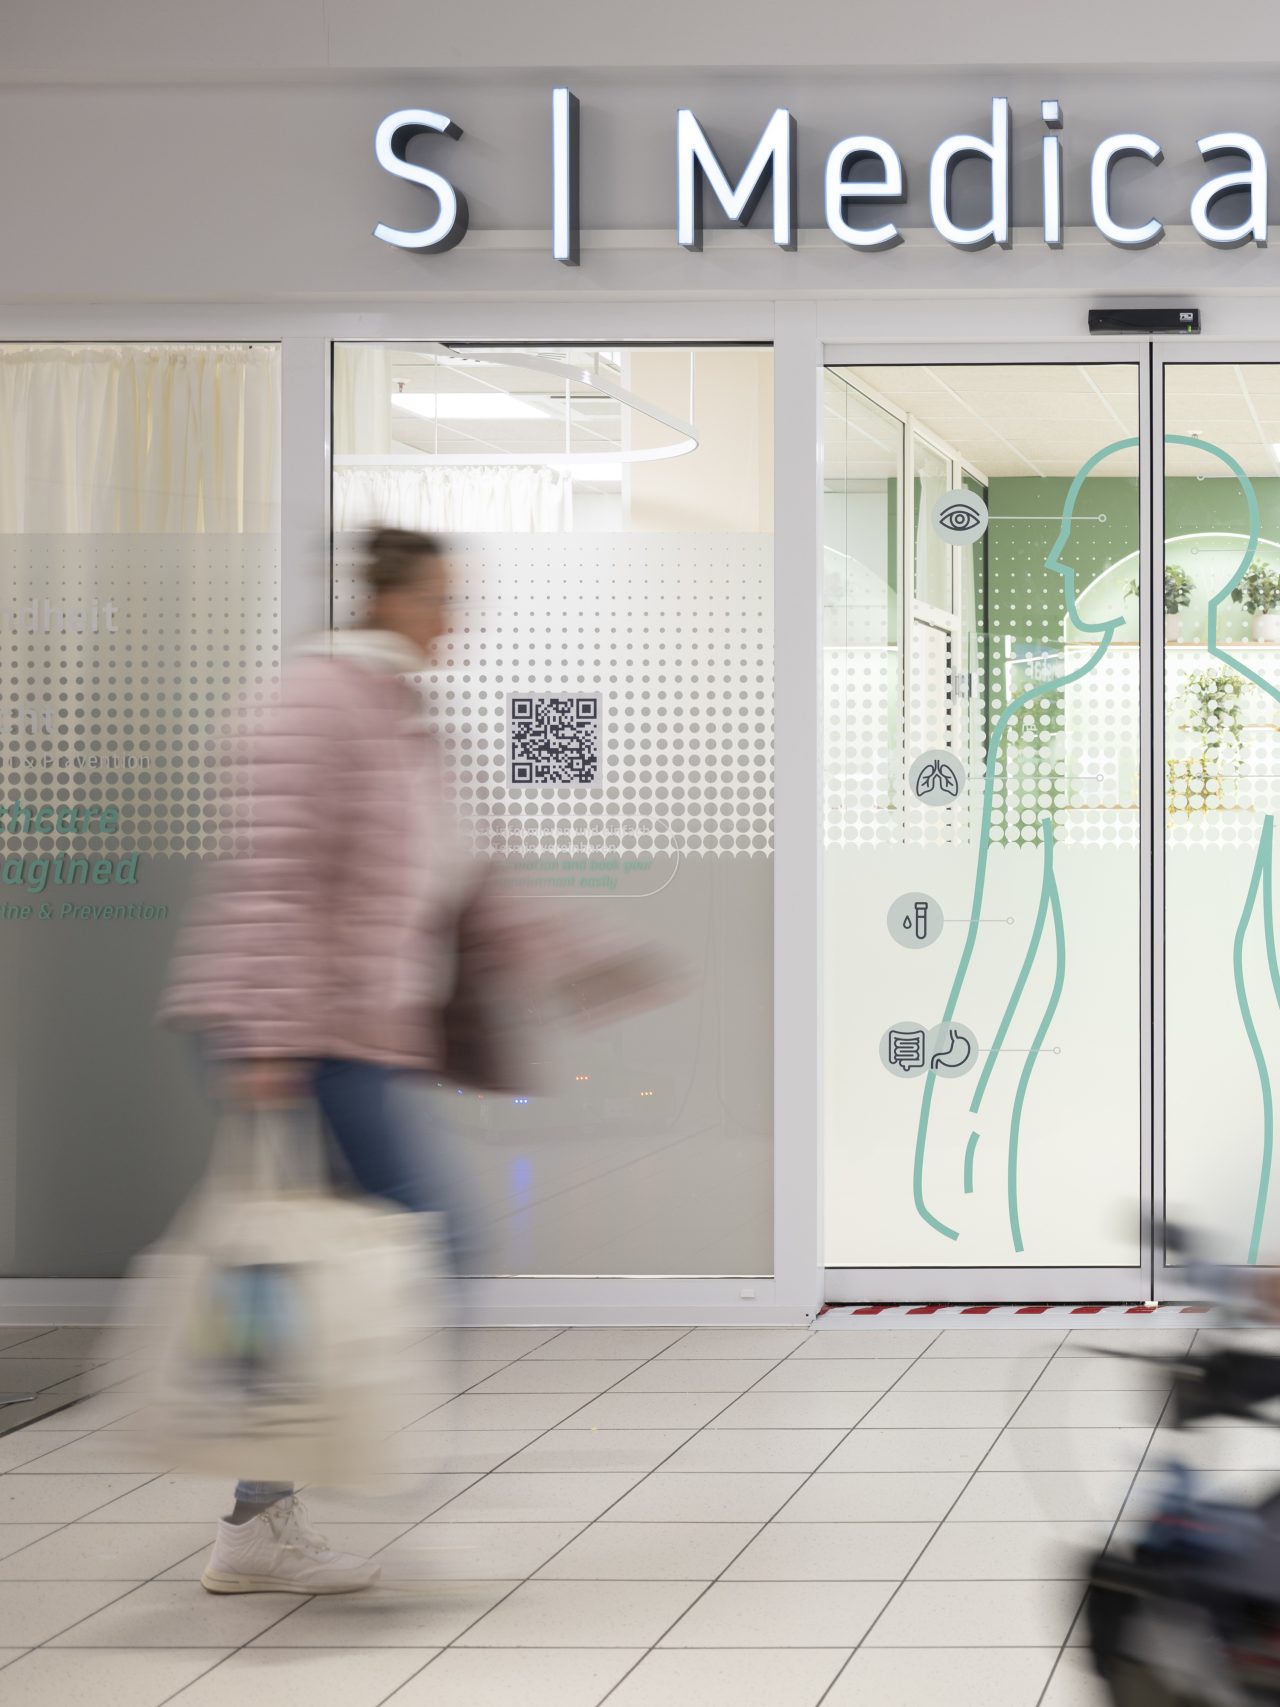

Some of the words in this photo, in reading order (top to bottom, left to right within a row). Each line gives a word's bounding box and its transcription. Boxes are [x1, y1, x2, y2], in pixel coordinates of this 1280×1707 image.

[371, 108, 468, 253] S
[38, 901, 52, 921] &
[59, 901, 169, 921] Prevention
